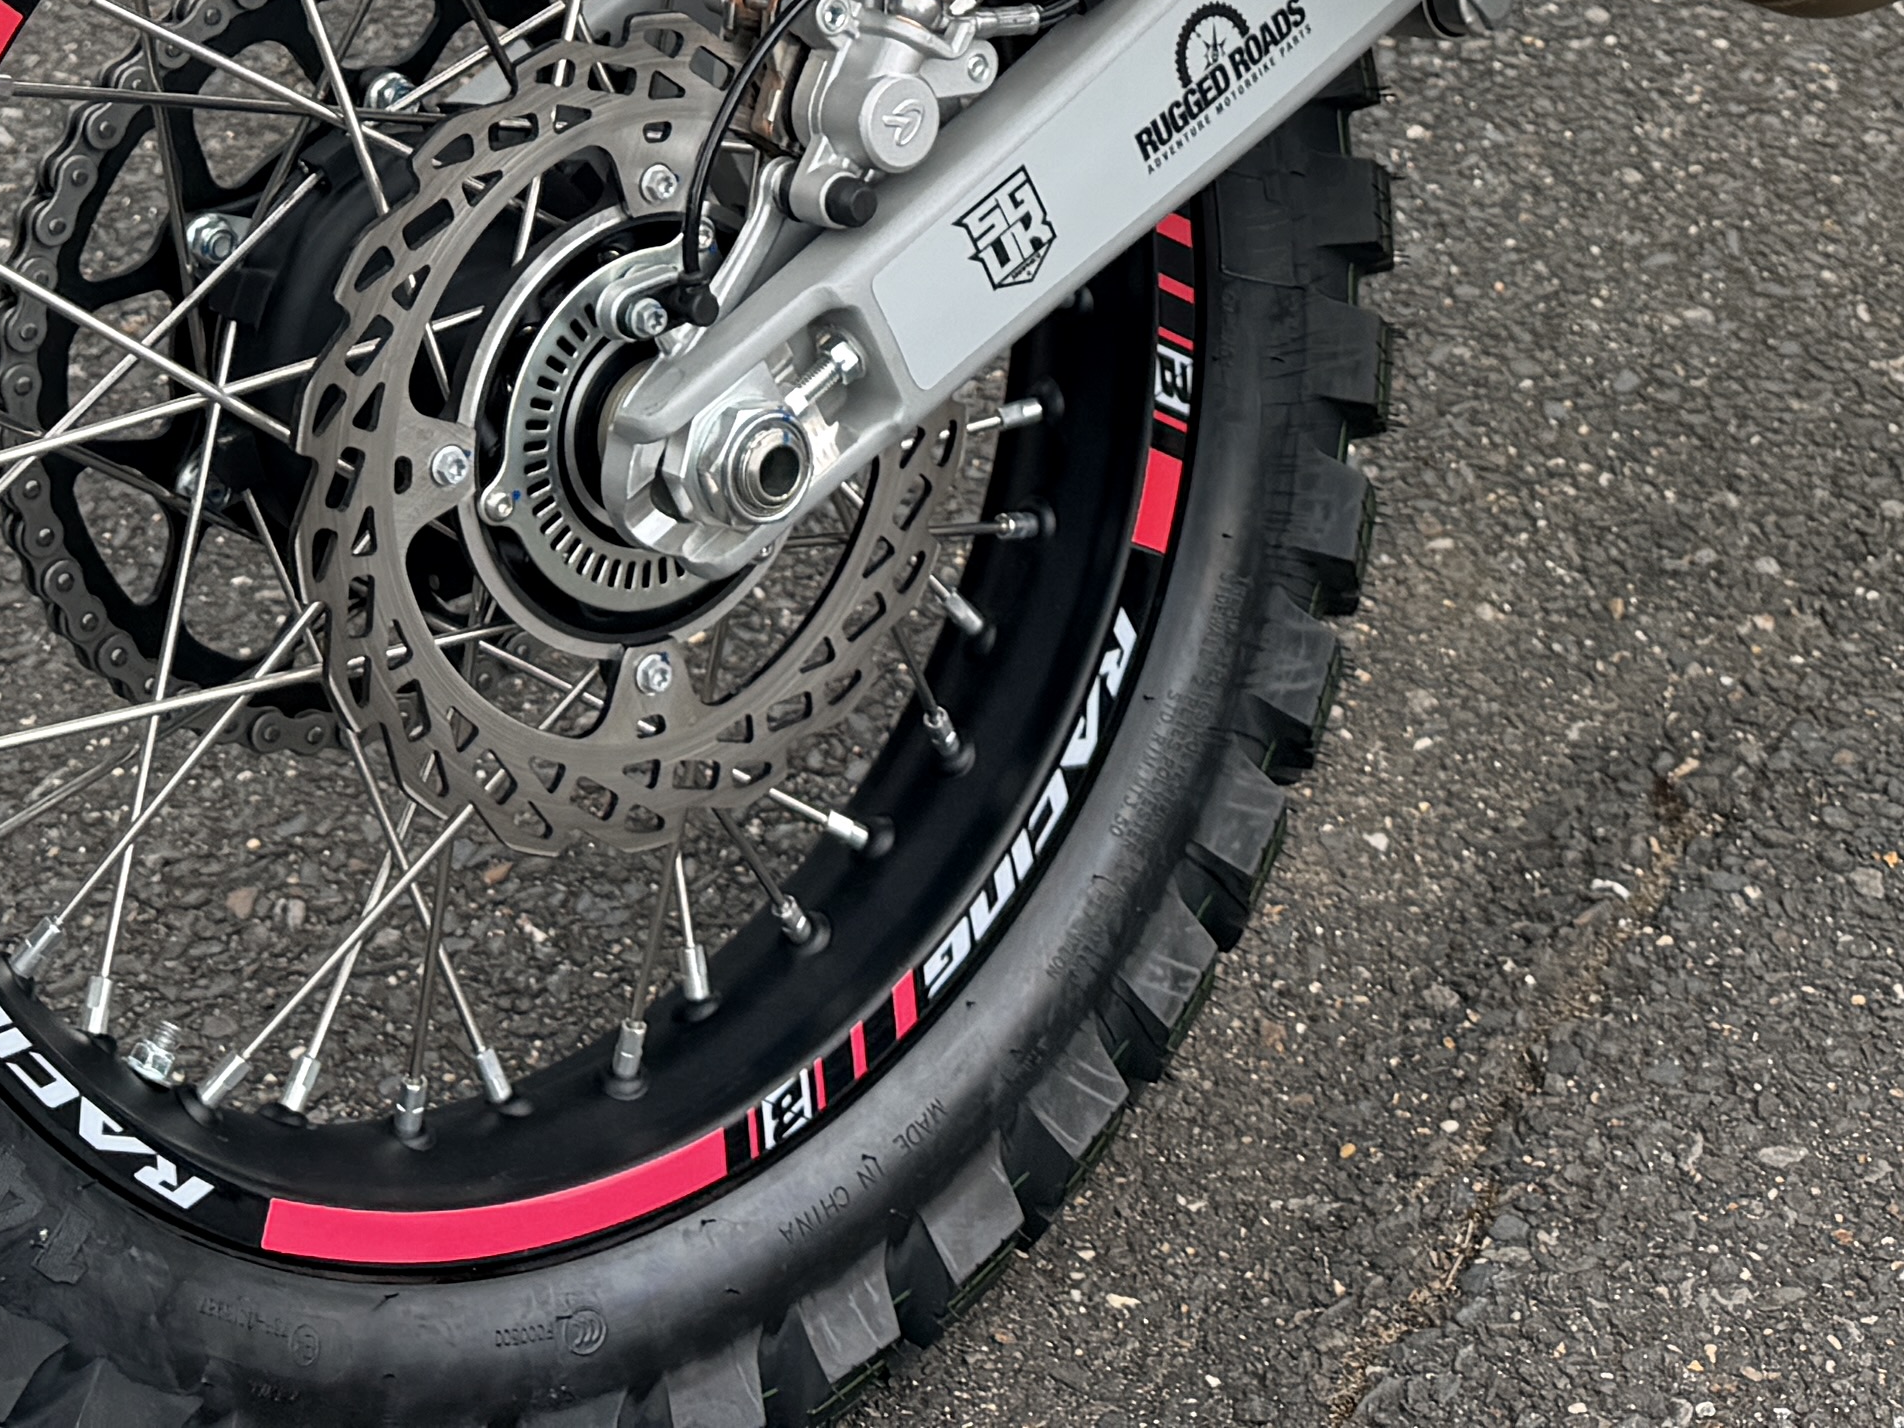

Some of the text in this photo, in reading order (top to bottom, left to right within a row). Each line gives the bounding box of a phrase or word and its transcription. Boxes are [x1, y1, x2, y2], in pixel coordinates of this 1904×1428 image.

[1134, 63, 1231, 163] RUGGED
[1146, 23, 1313, 175] ADVENTURE MOTORBIKE PARTS
[923, 606, 1138, 1001] RACING
[777, 1097, 949, 1244] MADE IN CHINA
